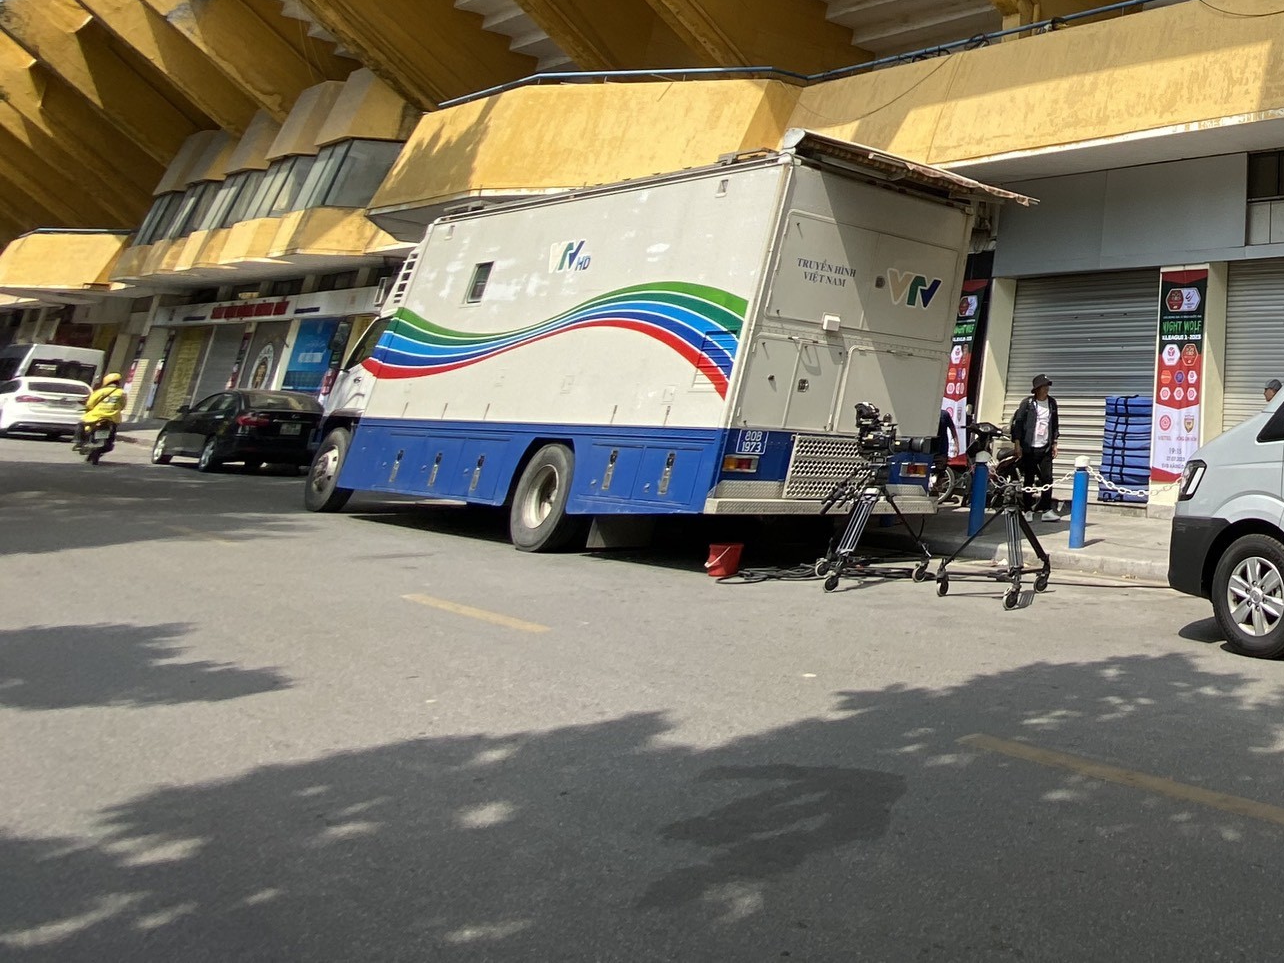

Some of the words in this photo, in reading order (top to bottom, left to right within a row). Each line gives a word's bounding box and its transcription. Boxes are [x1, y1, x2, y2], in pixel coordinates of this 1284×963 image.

[797, 258, 834, 274] TRUYỀN
[834, 264, 857, 278] HÌNH
[804, 271, 825, 284] VIỆT
[825, 276, 846, 287] NAM
[887, 268, 942, 309] VTV
[745, 430, 763, 441] 80B
[742, 441, 762, 453] 1973
